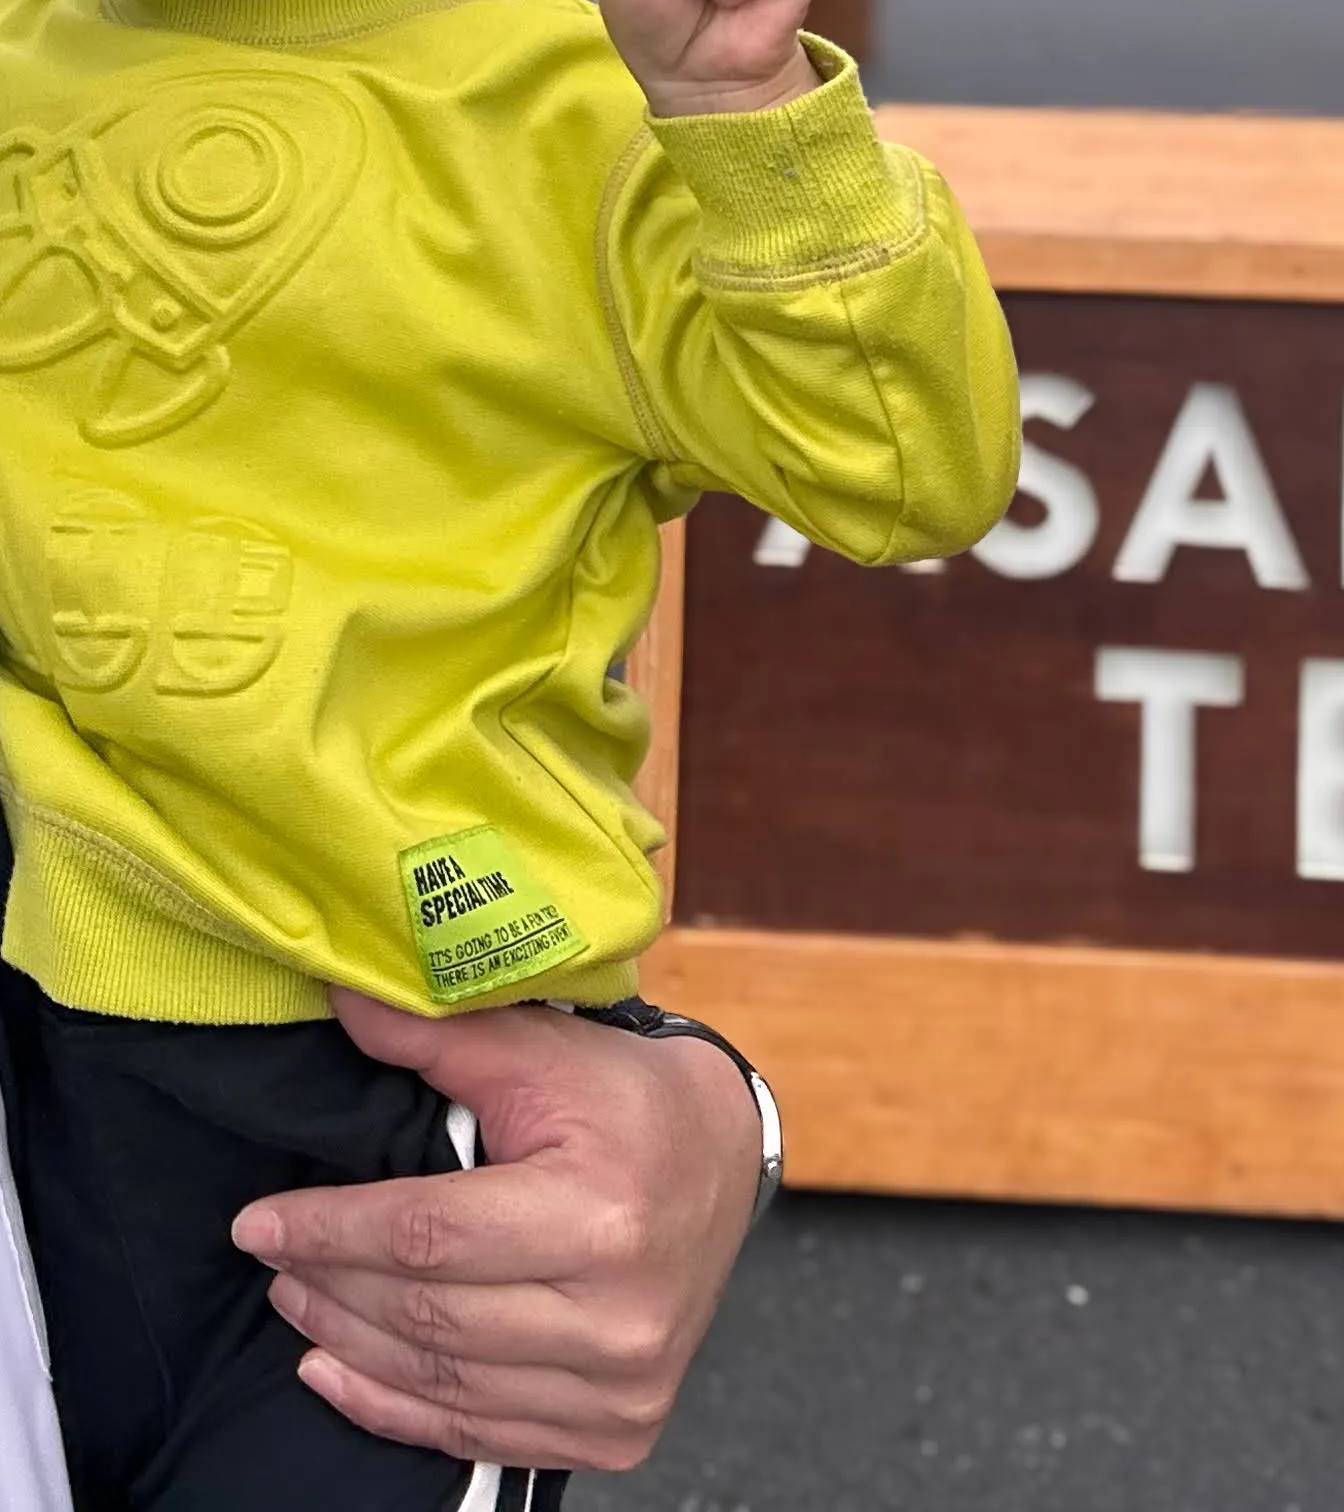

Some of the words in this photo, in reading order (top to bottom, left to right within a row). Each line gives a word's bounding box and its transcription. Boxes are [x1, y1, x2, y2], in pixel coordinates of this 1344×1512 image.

[413, 857, 456, 897] HAVE
[448, 855, 467, 880] A
[420, 879, 488, 928] SPECIAL
[476, 871, 516, 903] TIME
[428, 948, 453, 968] IT'S
[455, 932, 493, 960] GOING
[493, 926, 510, 945] TO
[508, 920, 523, 939] BE
[520, 917, 531, 932] A
[433, 966, 469, 988] THERE
[471, 961, 486, 980] IS
[488, 954, 502, 973] AN
[503, 934, 551, 968] EXCITING
